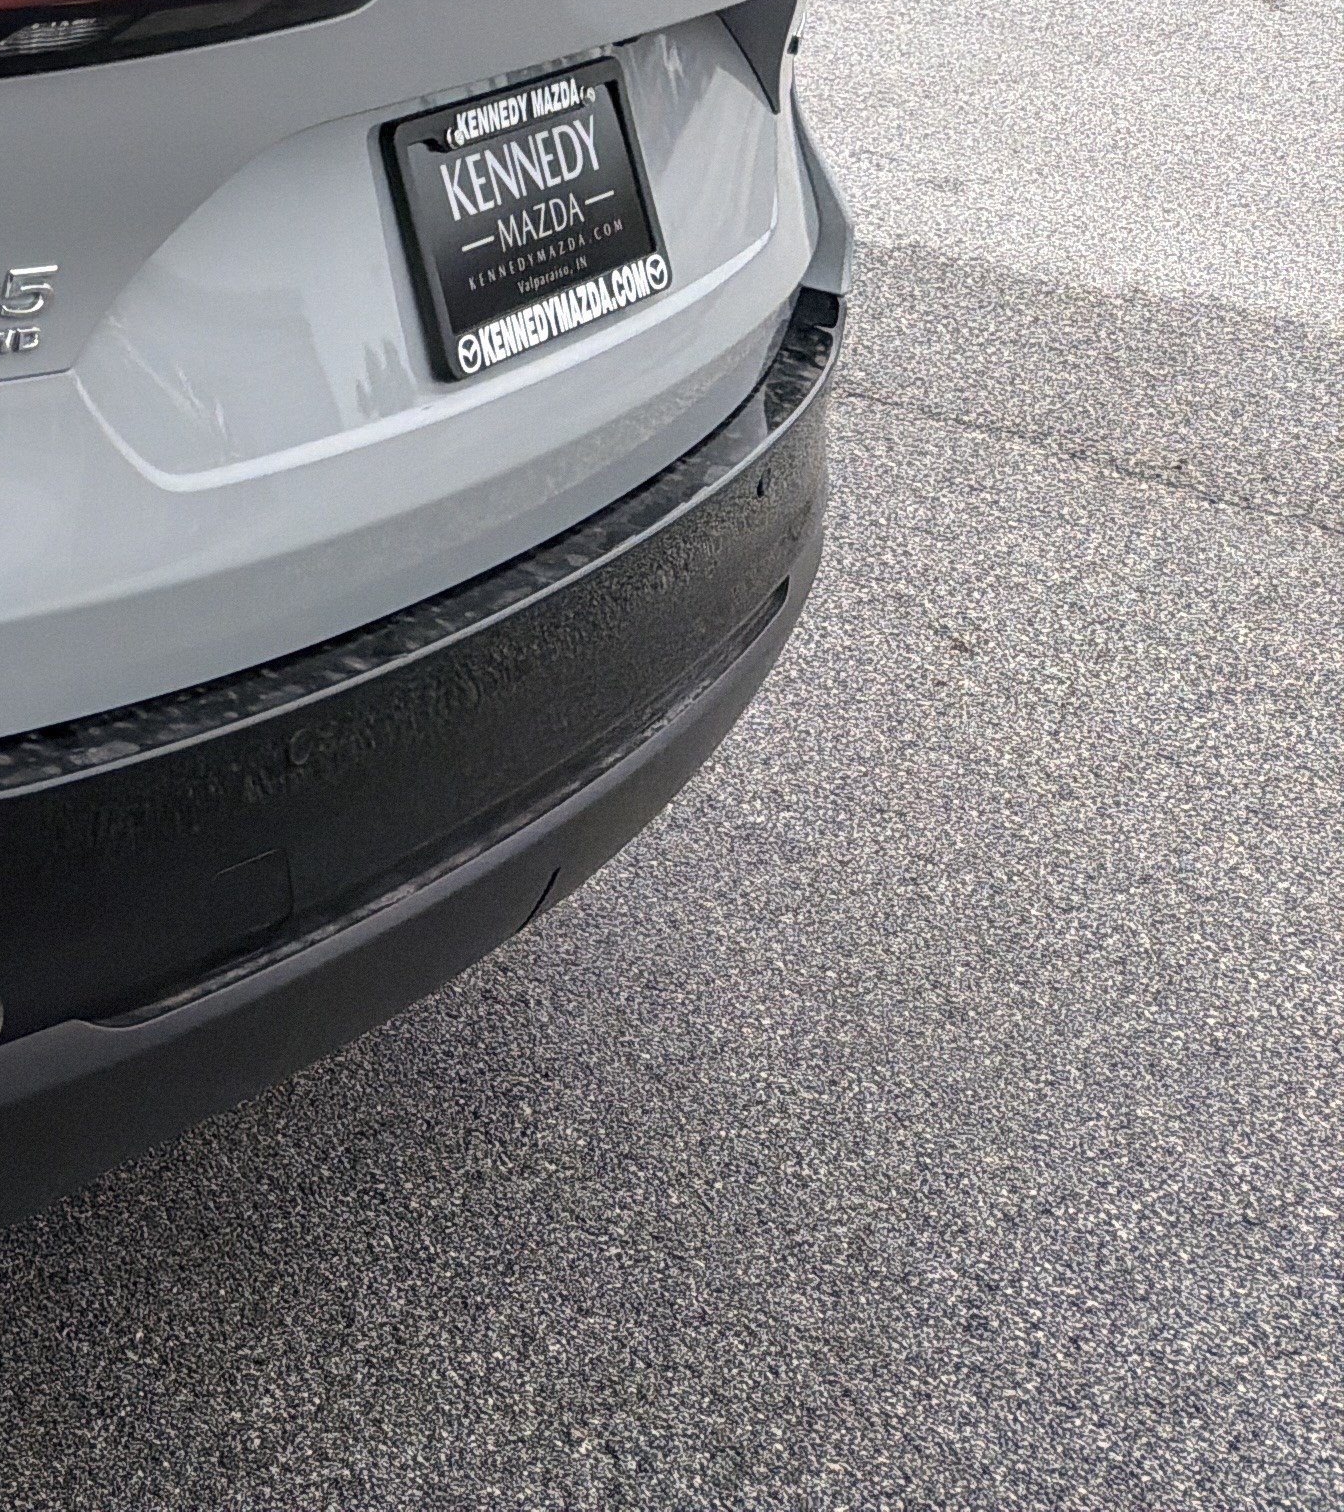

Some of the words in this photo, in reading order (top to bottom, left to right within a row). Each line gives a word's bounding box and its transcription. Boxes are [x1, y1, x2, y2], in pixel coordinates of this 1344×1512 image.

[456, 94, 527, 140] KENNEDY
[532, 78, 580, 118] MAZDA
[440, 115, 600, 221] KENNEDY
[468, 219, 623, 291] KENNEDYMAZDA.COM
[498, 193, 585, 252] MAZDA
[479, 259, 650, 366] KENNEDYMAZDA.COM
